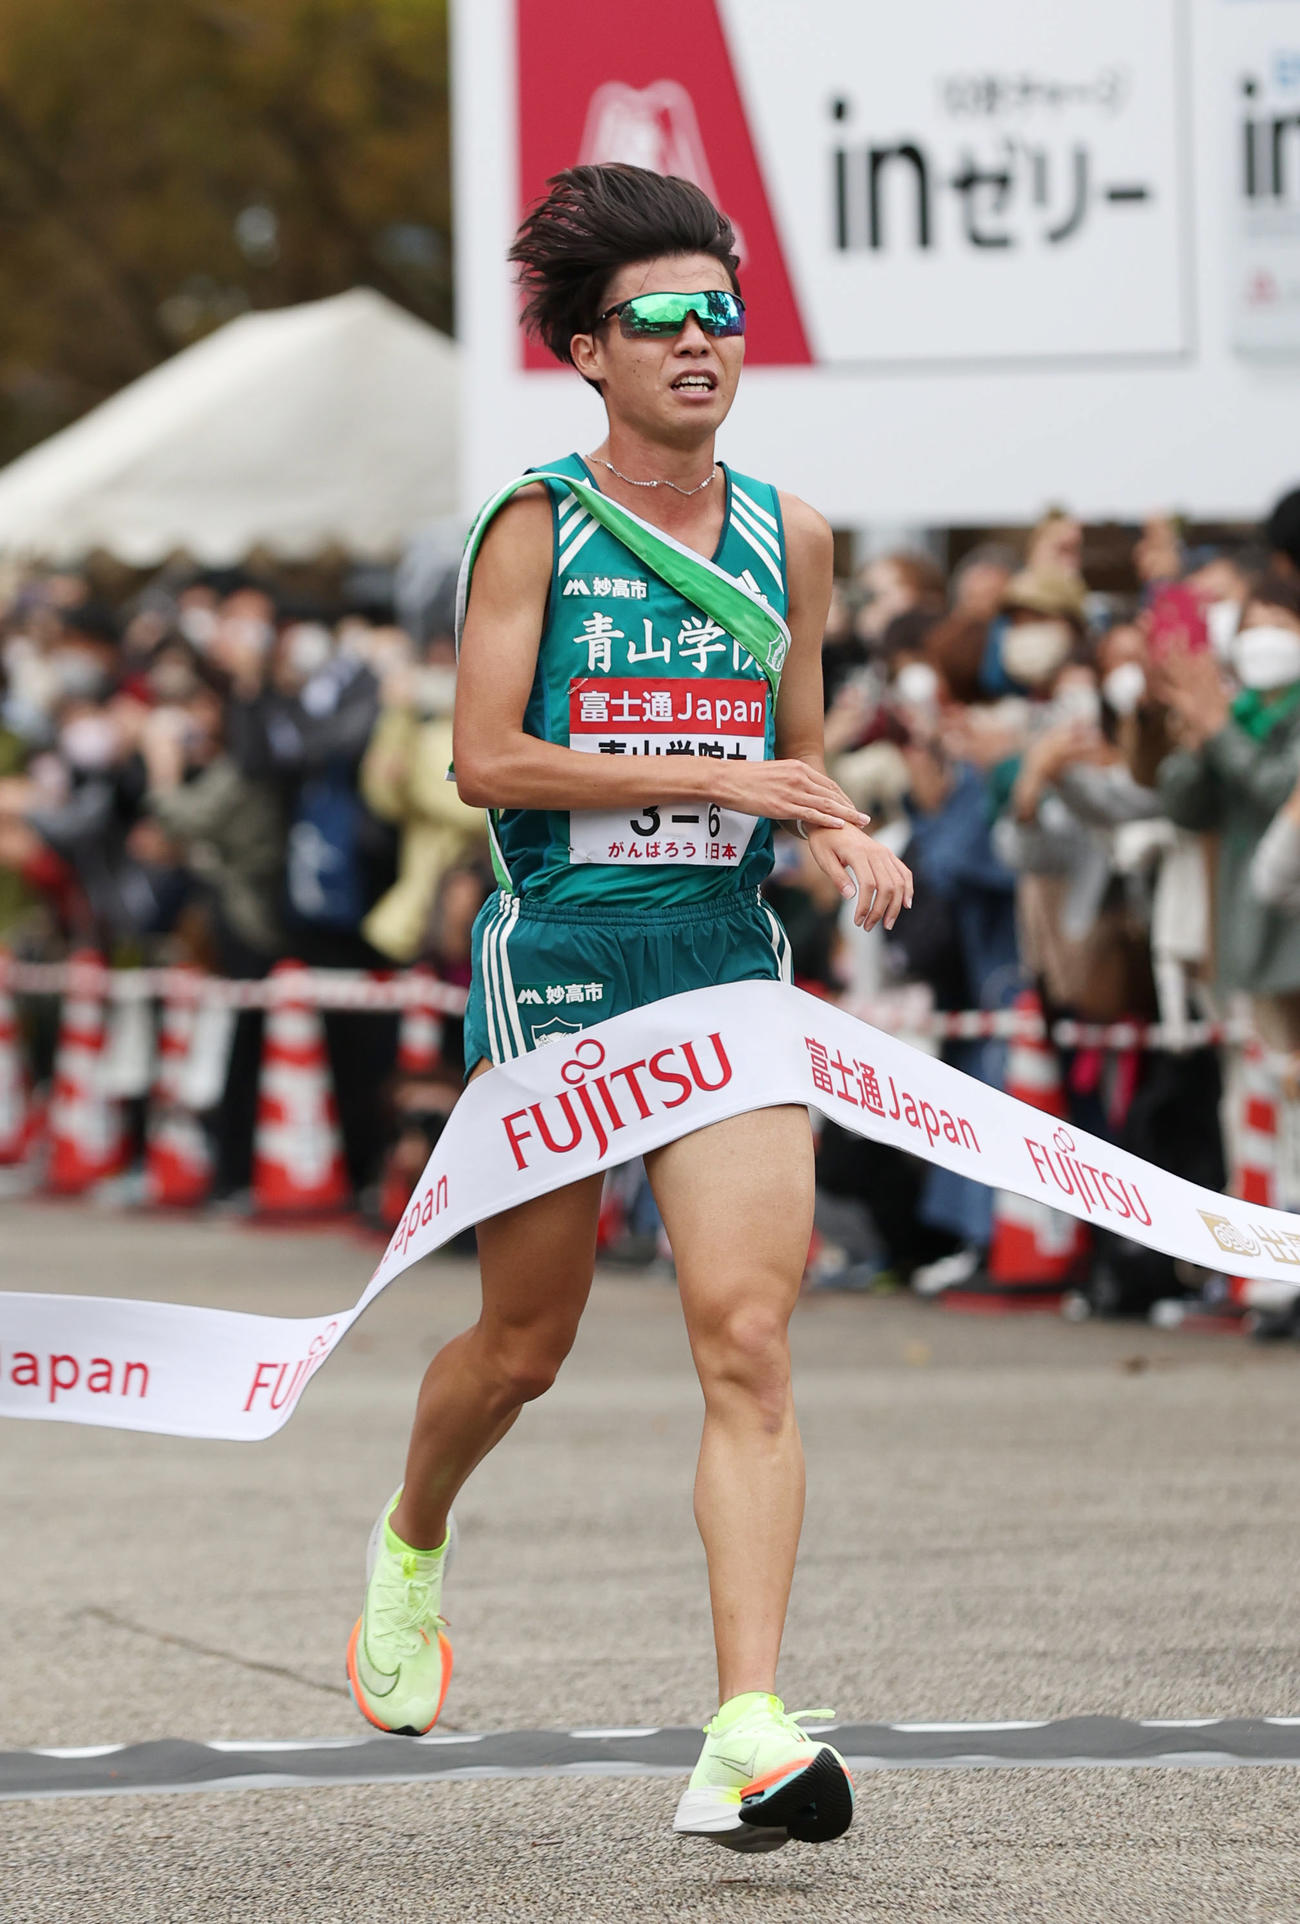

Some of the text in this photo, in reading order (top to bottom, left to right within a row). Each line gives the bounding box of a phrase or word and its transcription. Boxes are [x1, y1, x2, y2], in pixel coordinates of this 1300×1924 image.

[592, 576, 648, 600] 妙高市
[578, 690, 763, 729] 富士通Japan
[545, 982, 604, 1005] 妙高市
[501, 1032, 733, 1171] FUJITSU
[804, 1037, 982, 1154] 富士通Japan
[1023, 1130, 1153, 1227] FUJITSU
[0, 1344, 149, 1403] apan
